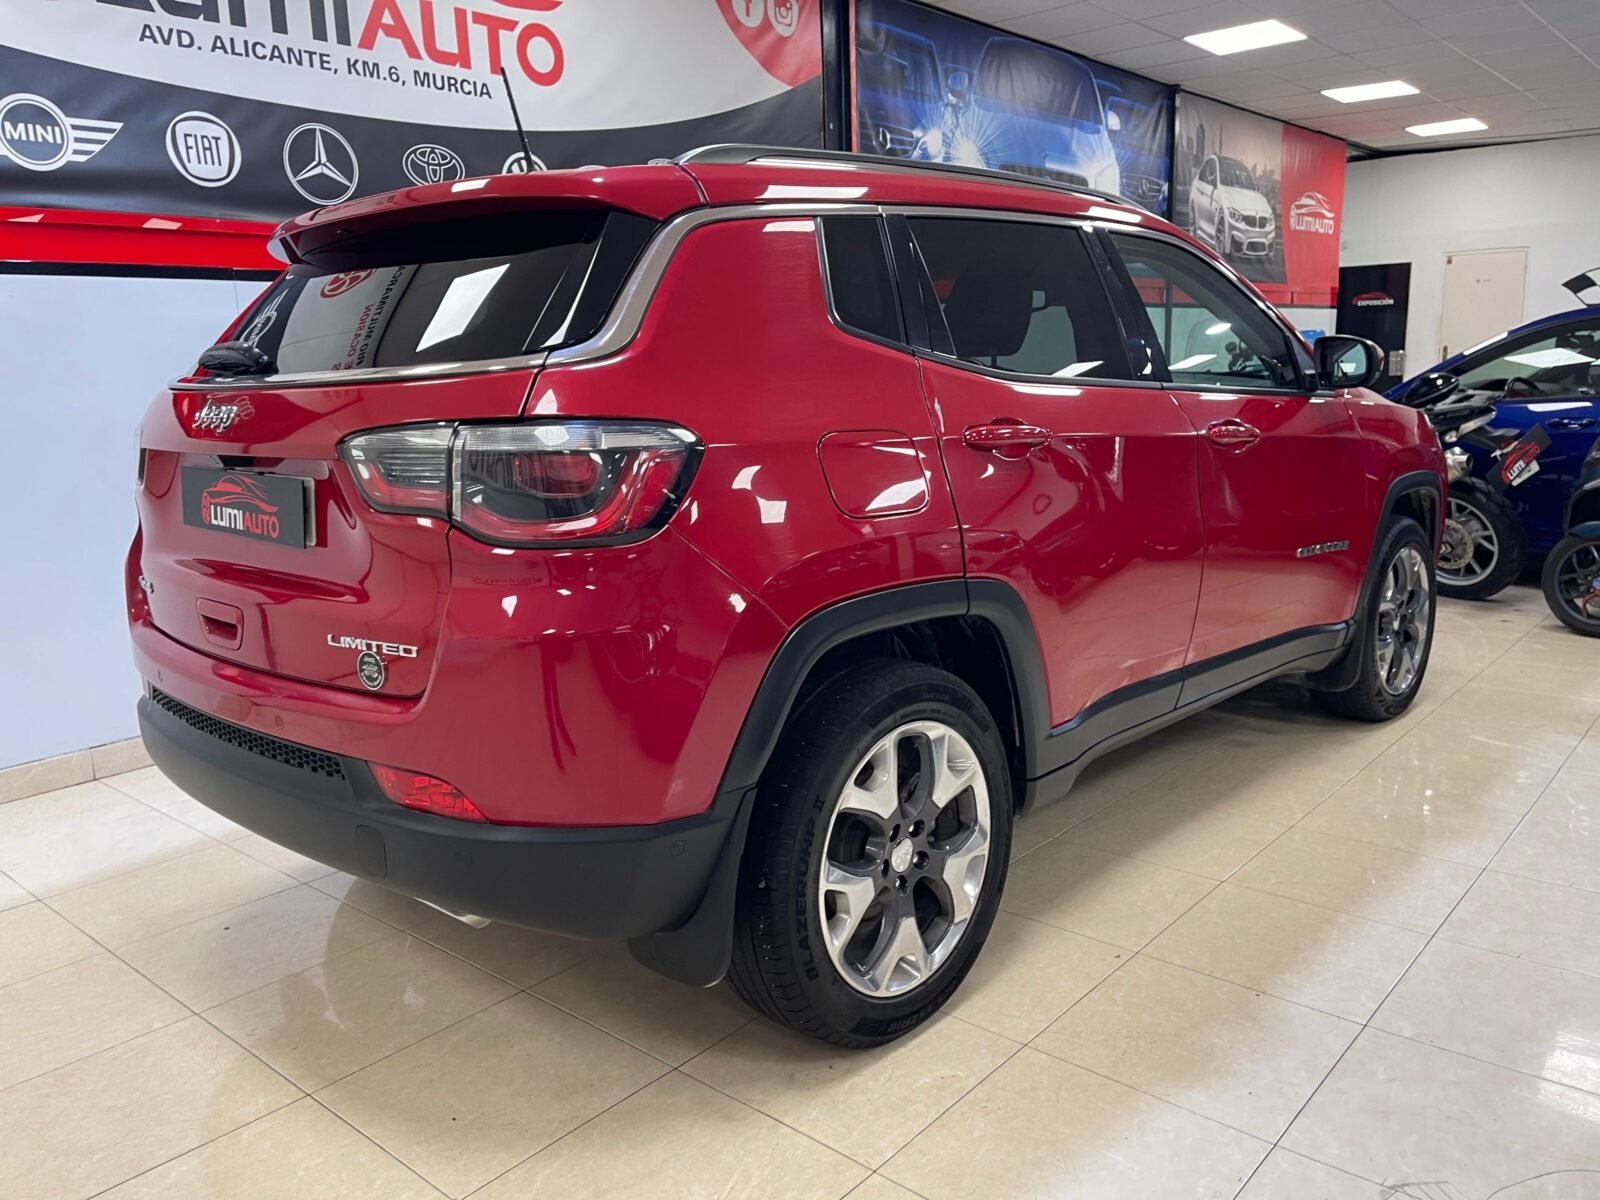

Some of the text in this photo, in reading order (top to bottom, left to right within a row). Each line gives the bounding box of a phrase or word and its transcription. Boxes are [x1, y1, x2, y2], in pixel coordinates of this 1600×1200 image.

[138, 23, 493, 99] AVD. ALICANTE, KM.6, MURCIA
[3, 120, 62, 144] MINI
[183, 132, 223, 167] FIAT
[192, 399, 239, 433] Jeep
[210, 504, 280, 539] LUMIAUTO
[326, 633, 419, 658] LIMITED
